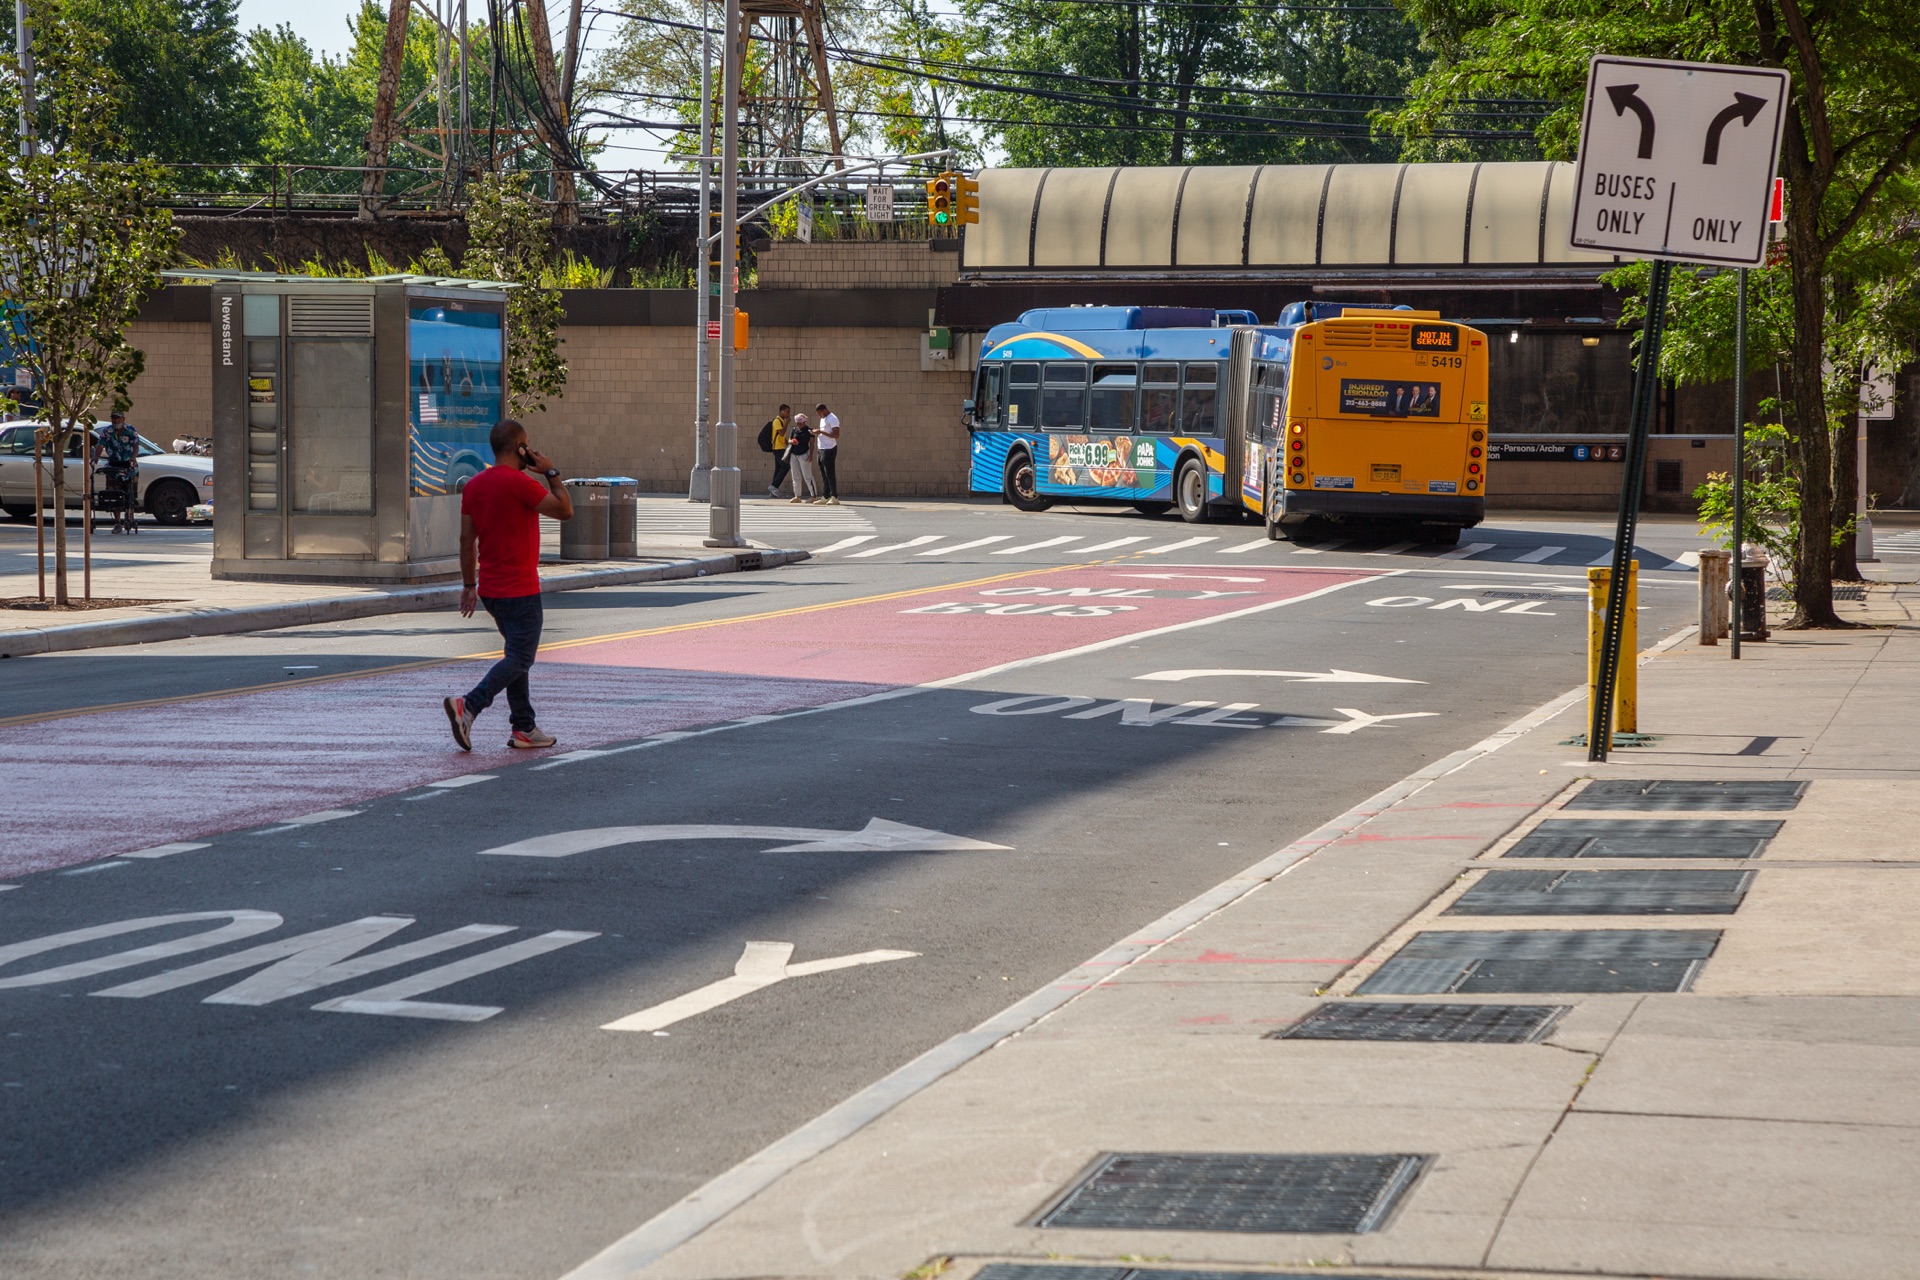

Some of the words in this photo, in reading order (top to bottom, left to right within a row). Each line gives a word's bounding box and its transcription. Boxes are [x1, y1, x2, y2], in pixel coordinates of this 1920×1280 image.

[872, 187, 888, 195] WAIT
[1595, 173, 1656, 200] BUSES
[1596, 208, 1645, 235] ONLY
[1692, 217, 1742, 244] ONLY
[221, 296, 234, 366] Newsstand
[1420, 331, 1437, 339] NOT
[1416, 338, 1452, 346] SERVICE
[1431, 355, 1463, 369] 5419
[1348, 383, 1385, 391] INJURED?
[1343, 389, 1389, 397] LESIONADO?
[1345, 399, 1386, 407] 212-463-8888
[1069, 444, 1081, 455] Pick
[1137, 443, 1154, 457] PAPA
[1577, 448, 1585, 457] E
[1594, 448, 1601, 457] J
[1611, 448, 1618, 457] Z
[1069, 457, 1078, 465] two
[1136, 457, 1154, 467] JOHNS
[978, 586, 1261, 600] ONLY
[896, 602, 1139, 617] BUS
[968, 695, 1441, 735] ONLY
